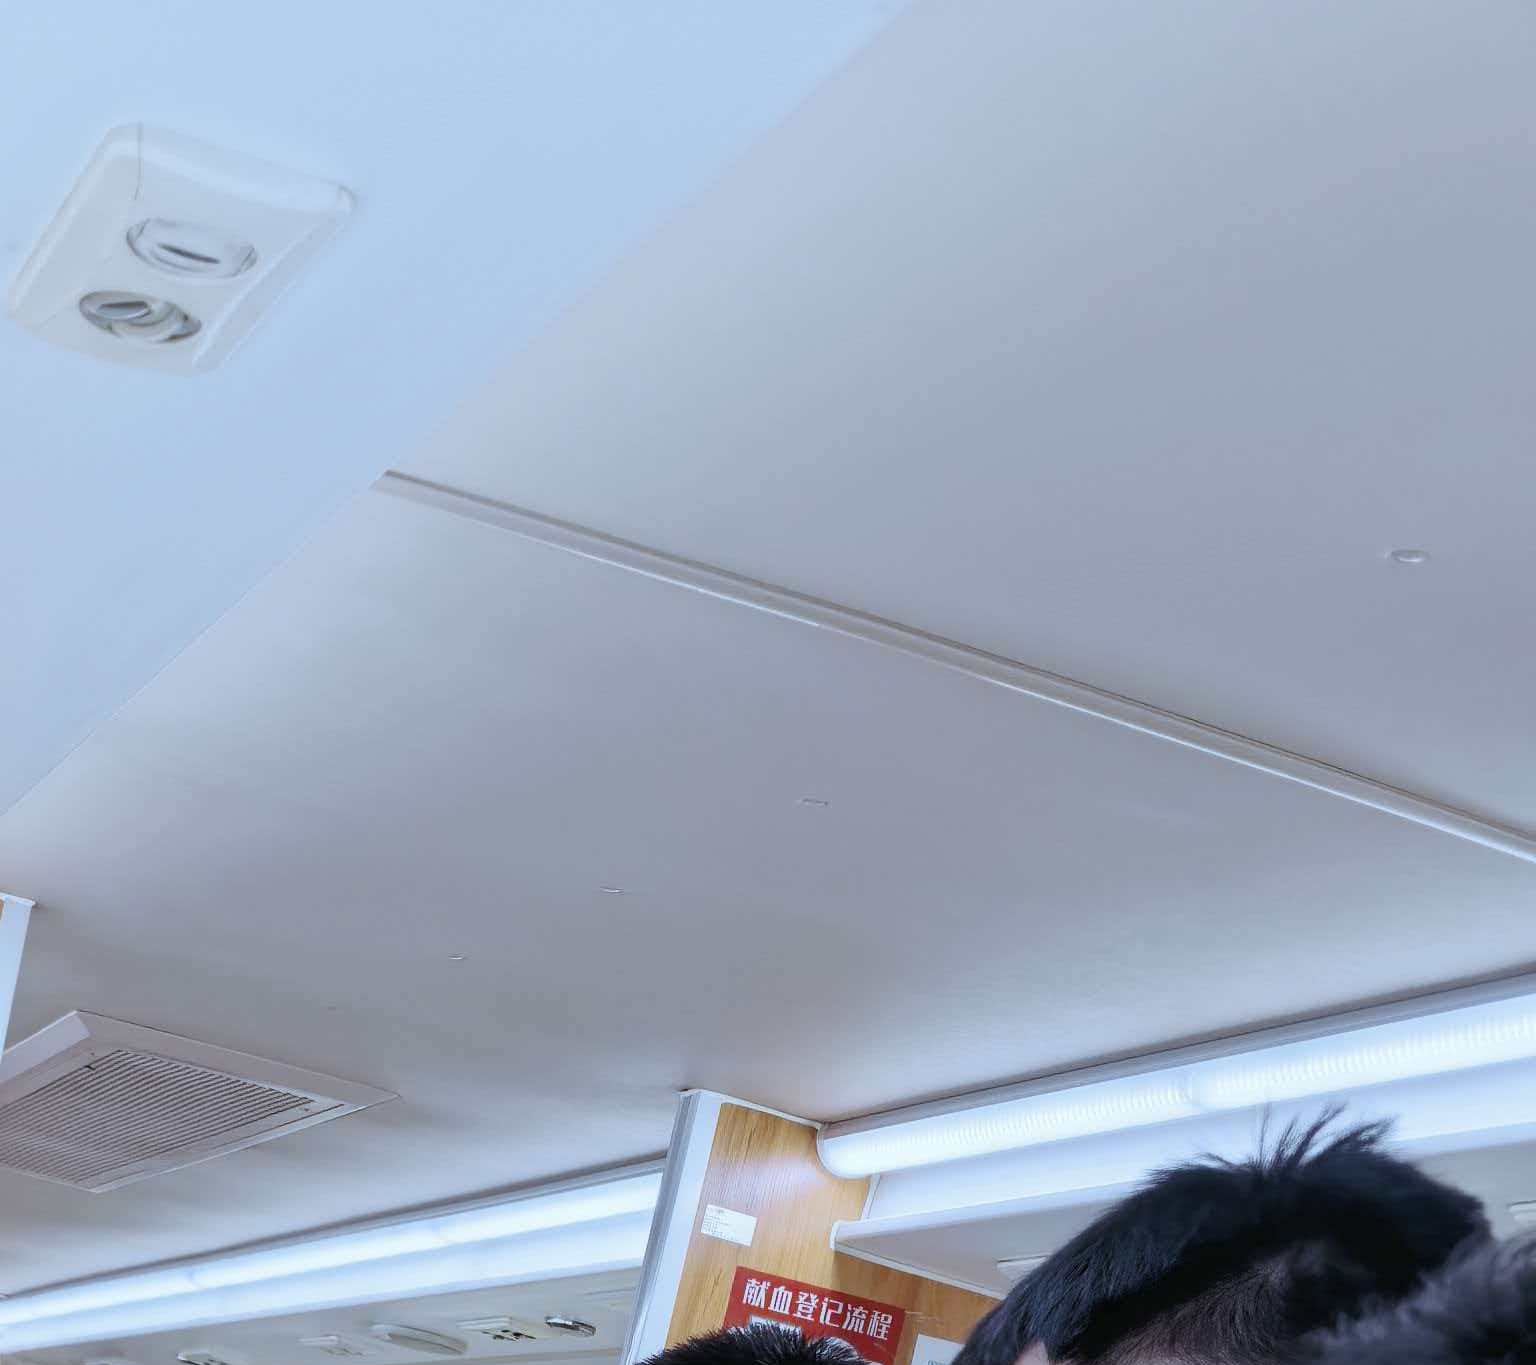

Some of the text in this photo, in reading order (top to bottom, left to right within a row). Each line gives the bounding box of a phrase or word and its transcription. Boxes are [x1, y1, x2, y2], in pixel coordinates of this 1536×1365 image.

[742, 1278, 894, 1342] 献血登记流程
